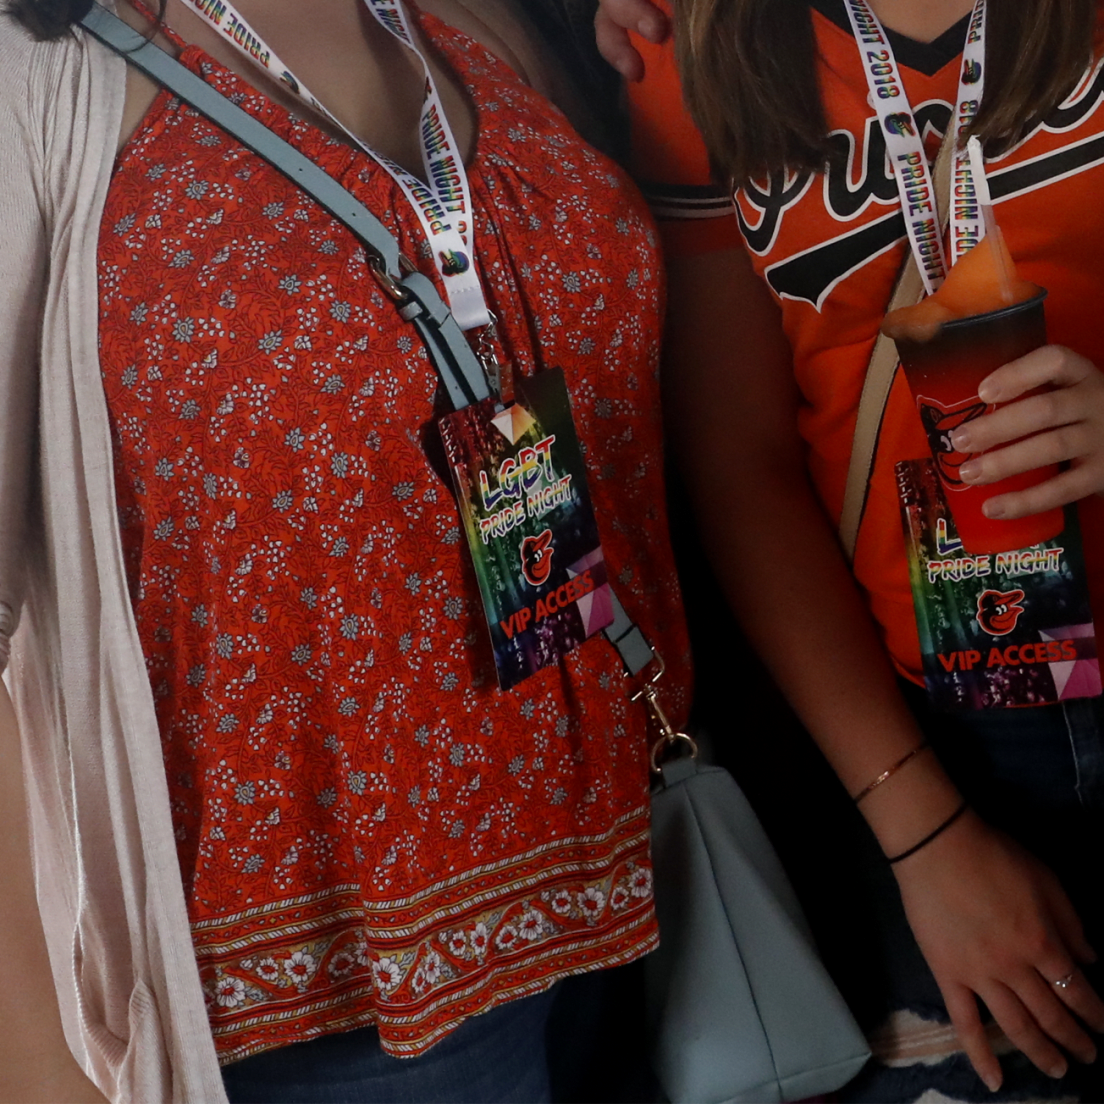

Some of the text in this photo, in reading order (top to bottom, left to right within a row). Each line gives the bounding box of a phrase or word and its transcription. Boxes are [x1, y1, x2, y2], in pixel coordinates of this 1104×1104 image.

[223, 13, 270, 68] PRIDE
[866, 50, 900, 100] 2018
[421, 104, 466, 214] PRIDE NIGHT
[953, 157, 978, 220] NIGHT
[402, 178, 452, 236] PRIDE
[897, 151, 946, 280] PRIDE NIGHT
[478, 435, 556, 511] LGBT
[478, 474, 572, 545] PRIDE NIGHT
[927, 546, 1065, 584] PRIDE NIGHT
[500, 569, 595, 640] VIP ACCESS
[937, 639, 1078, 673] VIP ACCESS
